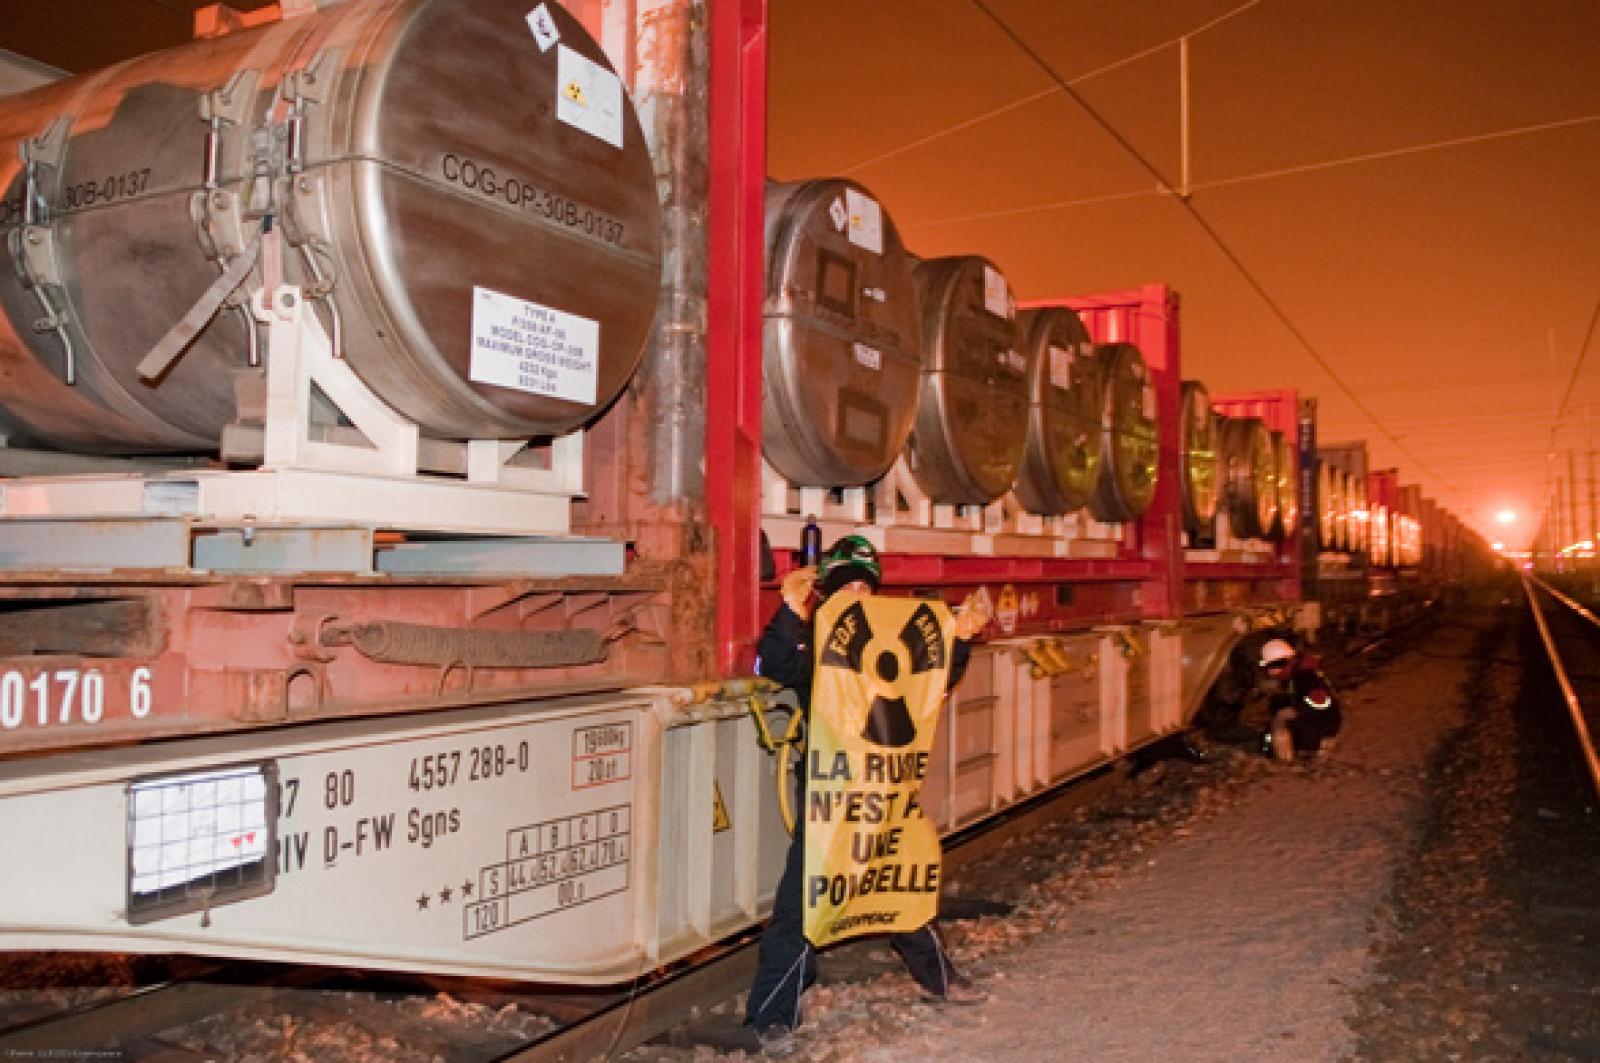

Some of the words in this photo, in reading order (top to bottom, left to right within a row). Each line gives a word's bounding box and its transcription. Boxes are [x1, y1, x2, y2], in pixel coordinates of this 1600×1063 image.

[442, 154, 624, 244] COG-OP-30B-0137
[131, 666, 152, 719] 6
[325, 768, 355, 810] 80
[408, 750, 461, 792] 4557
[468, 739, 530, 781] 288-0
[810, 749, 852, 781] LA
[323, 812, 396, 869] D-FW
[407, 806, 461, 848] Sgns
[851, 825, 904, 865] UNE
